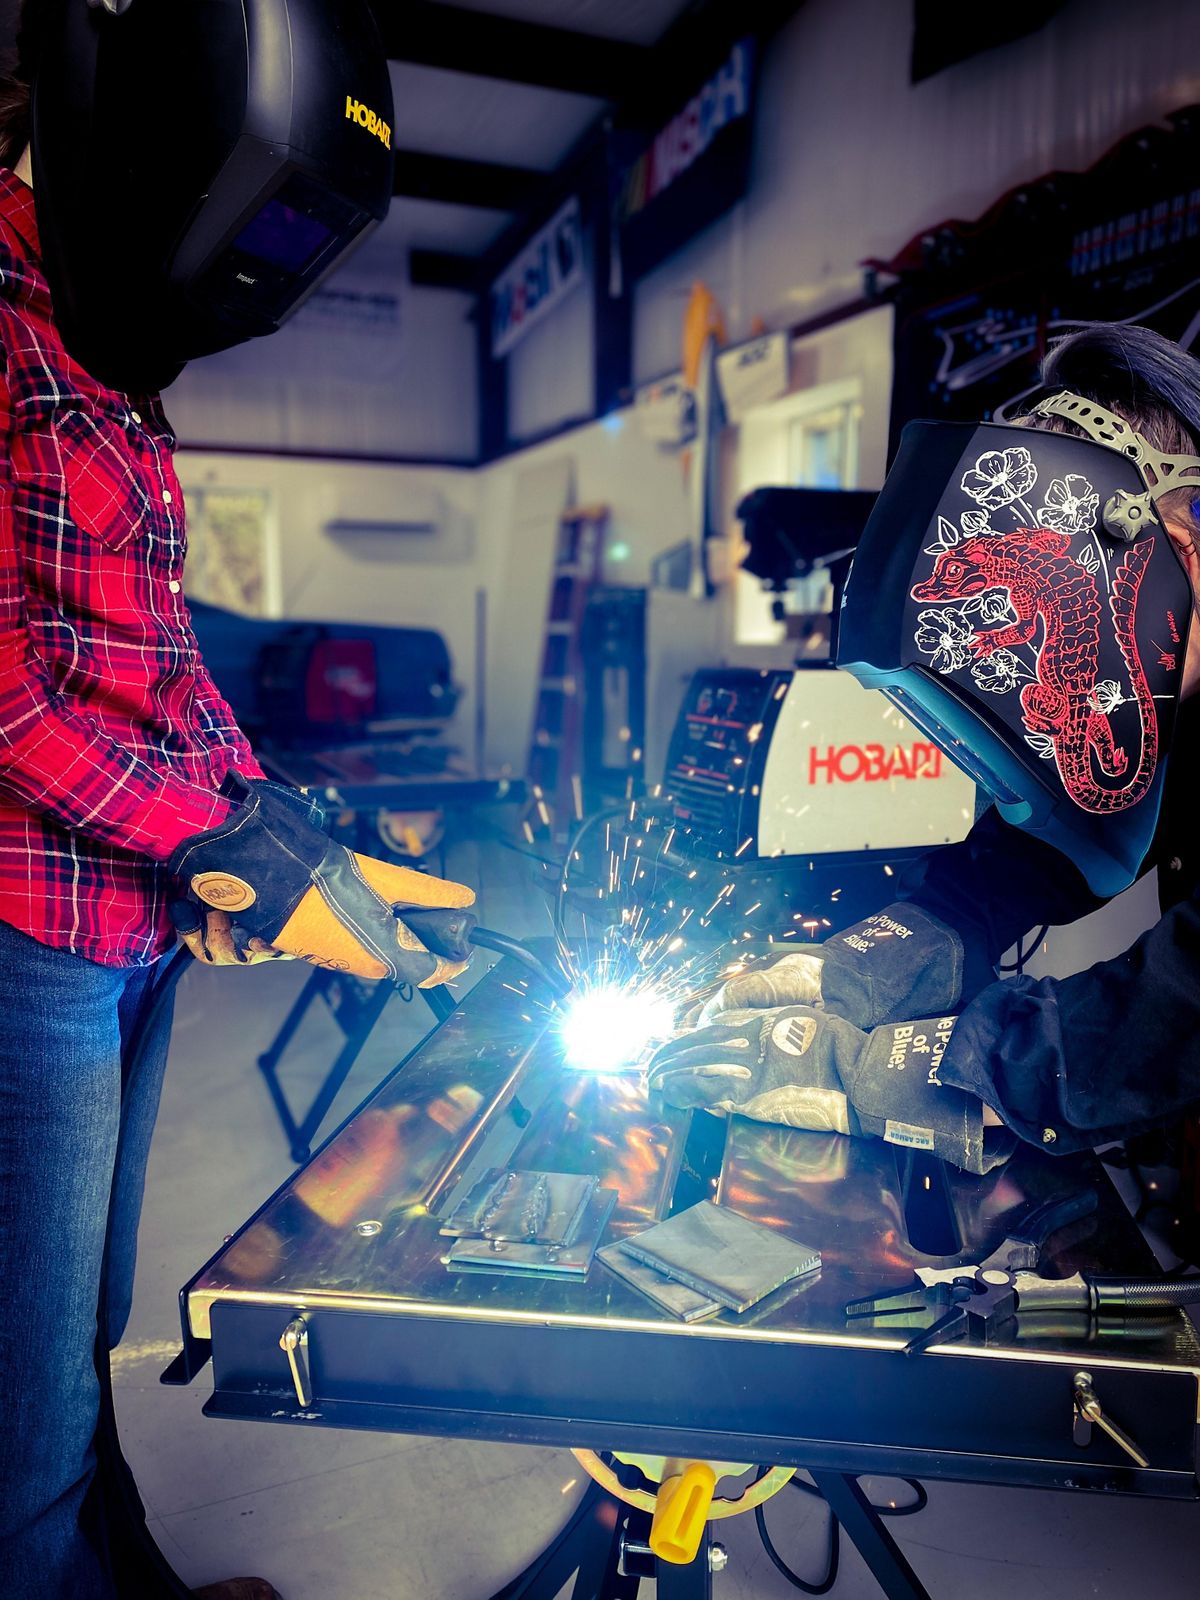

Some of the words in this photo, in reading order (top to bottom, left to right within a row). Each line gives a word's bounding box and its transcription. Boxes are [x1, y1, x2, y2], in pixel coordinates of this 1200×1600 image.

[345, 95, 391, 150] HOBART
[808, 742, 942, 785] HOBART
[862, 927, 881, 937] of
[873, 915, 914, 939] Power
[912, 1034, 931, 1054] of
